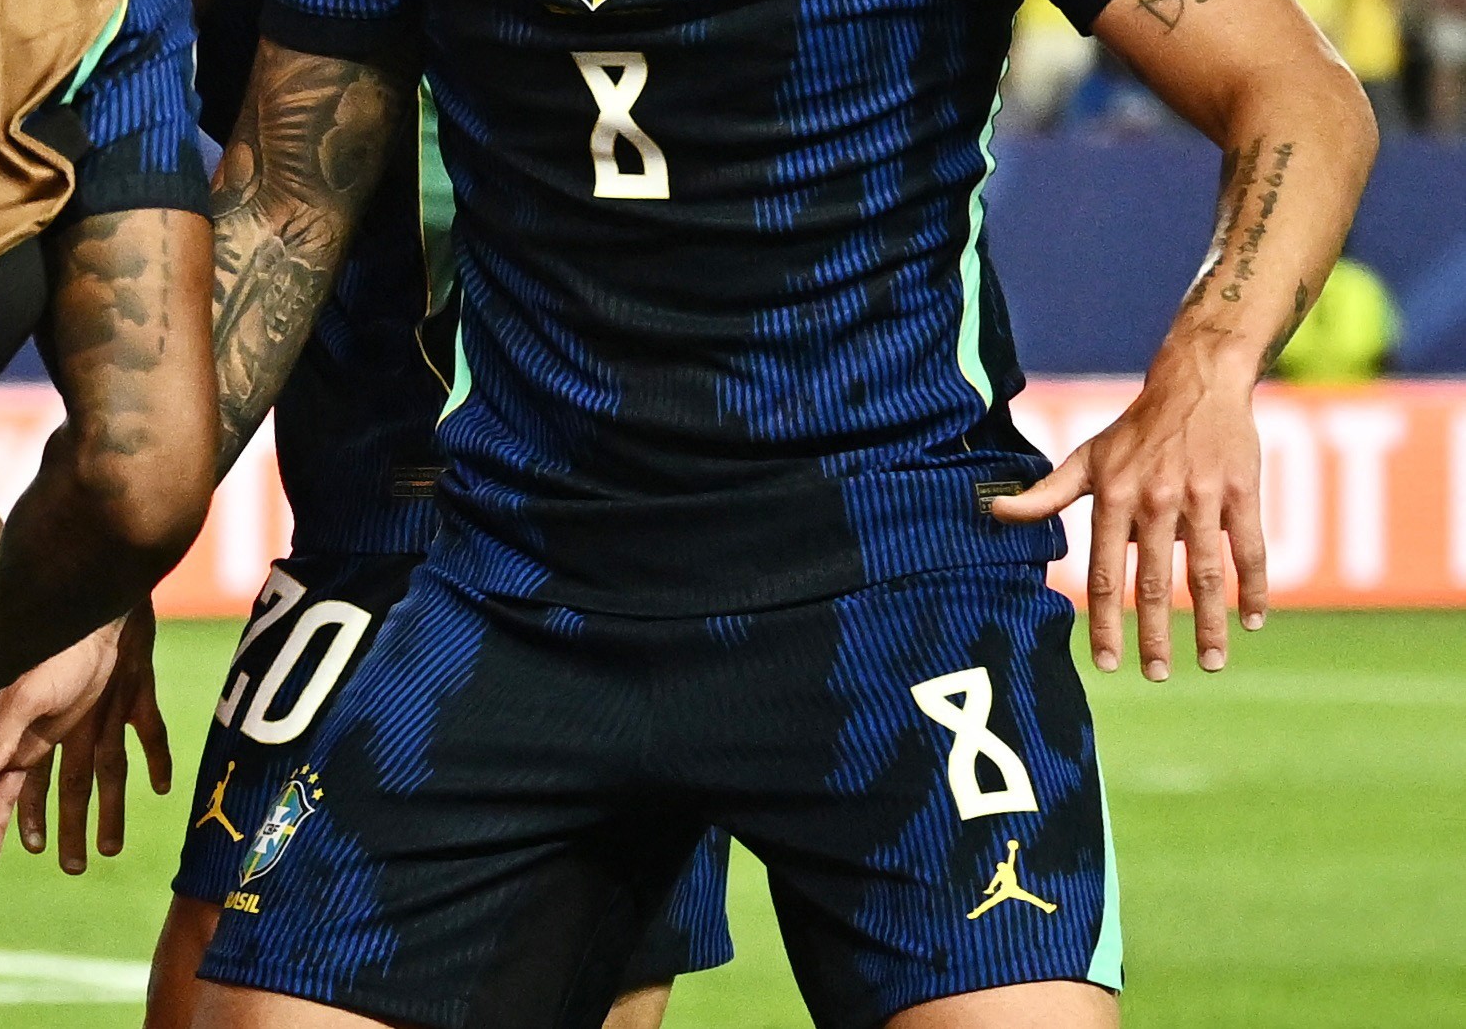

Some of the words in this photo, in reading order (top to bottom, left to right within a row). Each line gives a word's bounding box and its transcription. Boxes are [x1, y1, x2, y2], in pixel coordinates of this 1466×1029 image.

[569, 51, 671, 200] 8
[216, 563, 372, 745] 20
[910, 666, 1040, 822] 8
